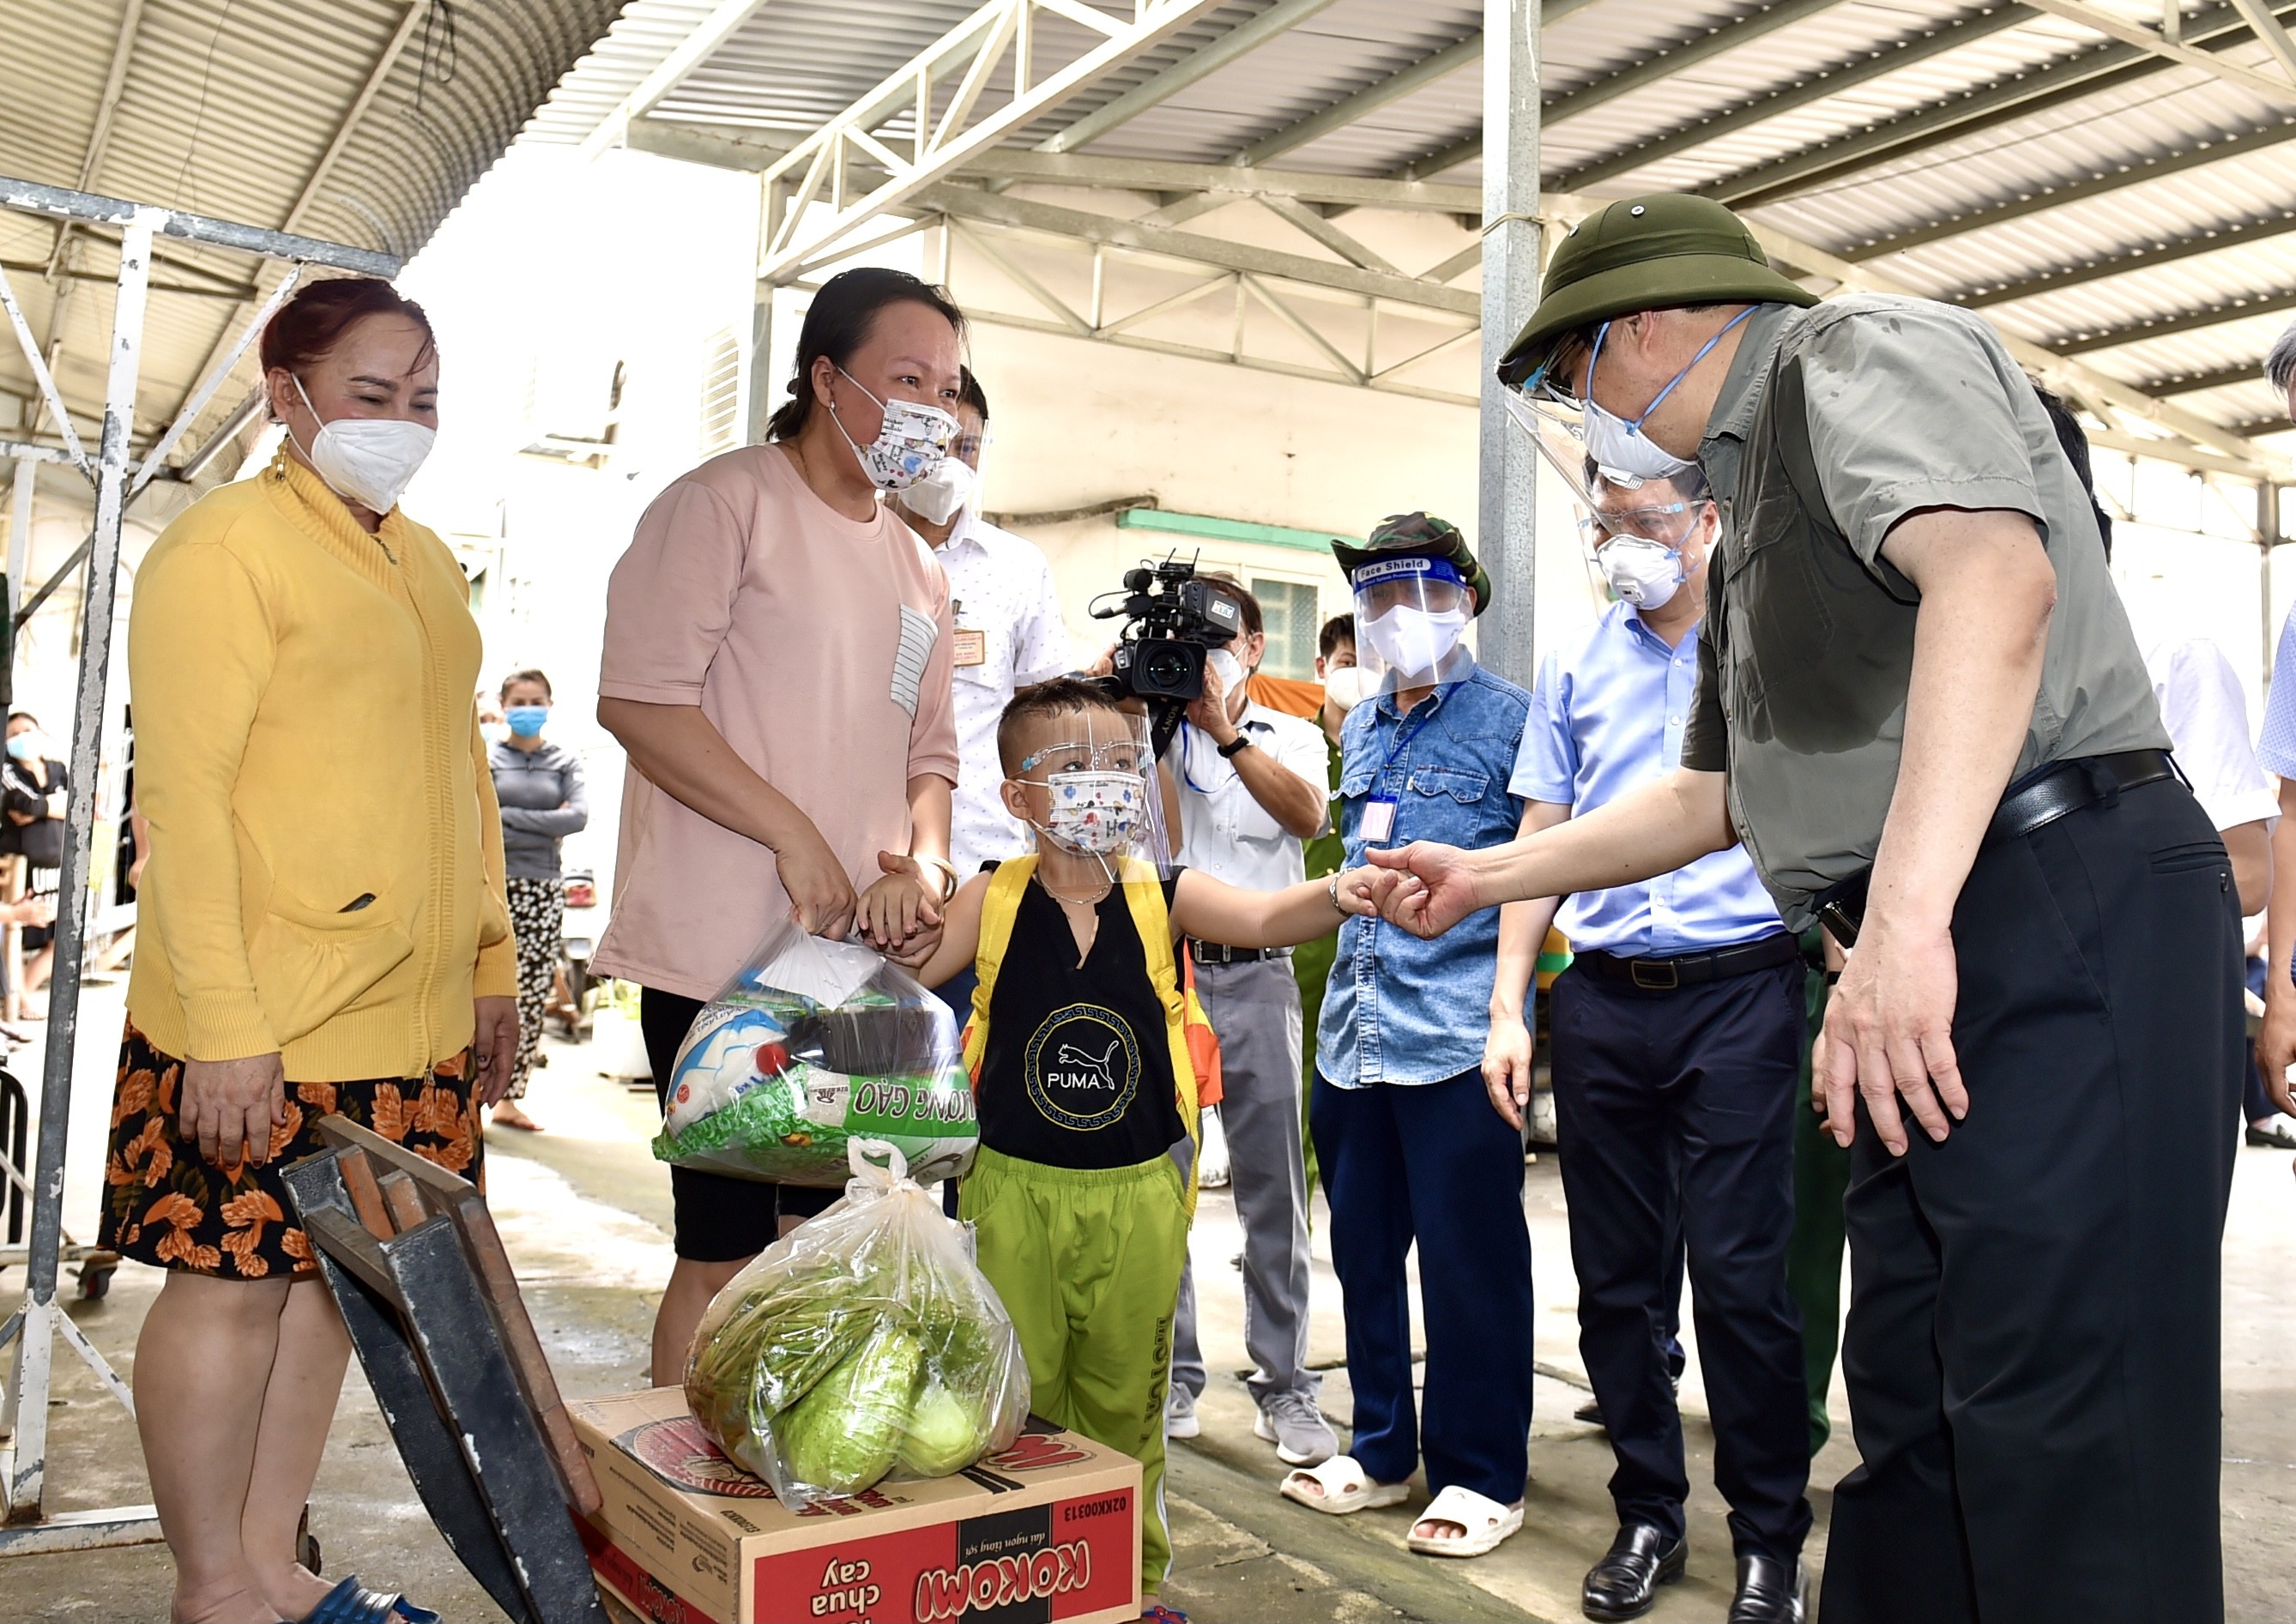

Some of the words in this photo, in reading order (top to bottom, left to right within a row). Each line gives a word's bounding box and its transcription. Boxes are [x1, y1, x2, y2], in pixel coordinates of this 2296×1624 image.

[1361, 566, 1381, 579] Face
[1386, 559, 1424, 571] Shield
[1162, 705, 1179, 734] SONY
[735, 1082, 752, 1095] kg
[1047, 1072, 1100, 1090] PUMA
[853, 1078, 911, 1119] GẠO
[1064, 1496, 1127, 1523] 02KK00313
[1005, 1532, 1029, 1551] ngon
[1030, 1532, 1046, 1547] dai
[964, 1544, 979, 1559] sợi
[820, 1556, 871, 1591] cay
[914, 1537, 1091, 1624] KOKOMI
[810, 1582, 881, 1618] chua
